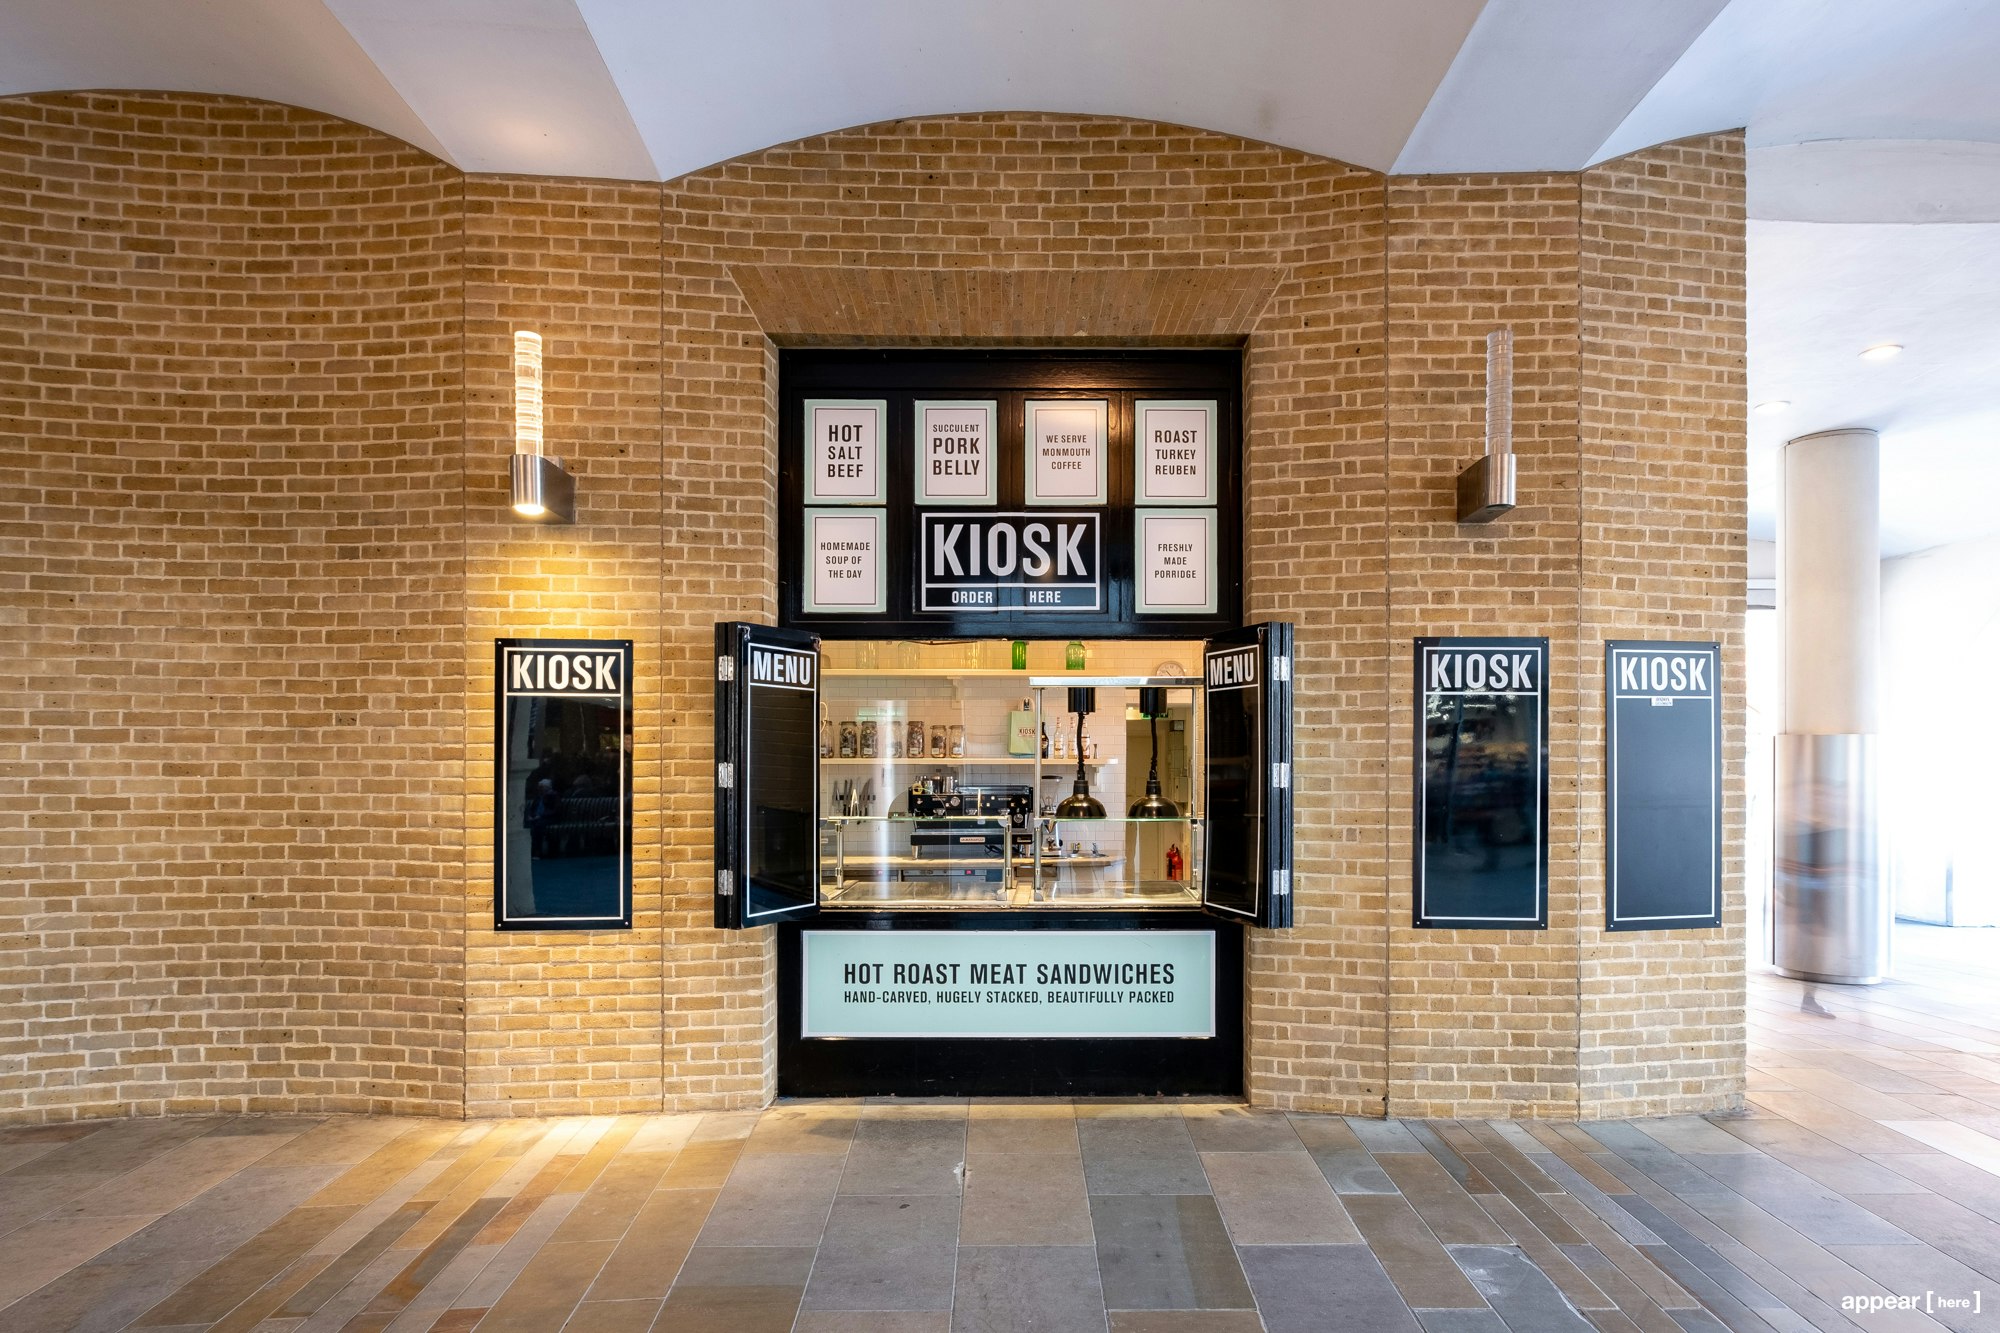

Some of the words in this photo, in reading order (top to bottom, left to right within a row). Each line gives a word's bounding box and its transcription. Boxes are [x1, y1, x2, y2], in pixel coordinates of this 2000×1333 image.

[829, 425, 862, 442] HOT
[933, 424, 979, 432] SUCCULENT
[1046, 435, 1058, 443] WE
[1062, 435, 1086, 443] SERVE
[1155, 430, 1197, 443] ROAST
[828, 446, 862, 459] SALT
[934, 438, 979, 454] PORK
[1043, 448, 1090, 456] MONMOUTH
[1156, 450, 1195, 459] TURKEY
[828, 464, 863, 477] BEEF
[933, 460, 979, 475] BELLY
[1156, 465, 1195, 475] REUBEN
[821, 542, 870, 550] HOMEMADE
[935, 523, 1087, 576] KIOSK
[826, 556, 848, 564] SOUP
[852, 556, 861, 564] OF
[1164, 557, 1186, 565] MADE
[829, 570, 843, 578] THE
[847, 570, 861, 578] DAY
[1155, 570, 1196, 578] PORRIDGE
[952, 591, 992, 603] ORDER
[1030, 591, 1061, 602] HERE
[514, 655, 616, 689] KIOSK
[754, 651, 810, 685] MENU
[1210, 652, 1254, 686] MENU
[1431, 654, 1532, 688] KIOSK
[1621, 657, 1707, 691] KIOSK
[845, 964, 883, 984] HOT
[894, 964, 960, 984] ROAST
[971, 964, 1027, 984] MEAT
[1037, 964, 1174, 984] SANDWICHES
[845, 991, 931, 1005] HAND-CARVED,
[937, 991, 981, 1003] HUGELY
[987, 991, 1041, 1004] STACKED,
[1048, 991, 1123, 1003] BEAUTIFULLY
[1130, 991, 1173, 1003] PACKED
